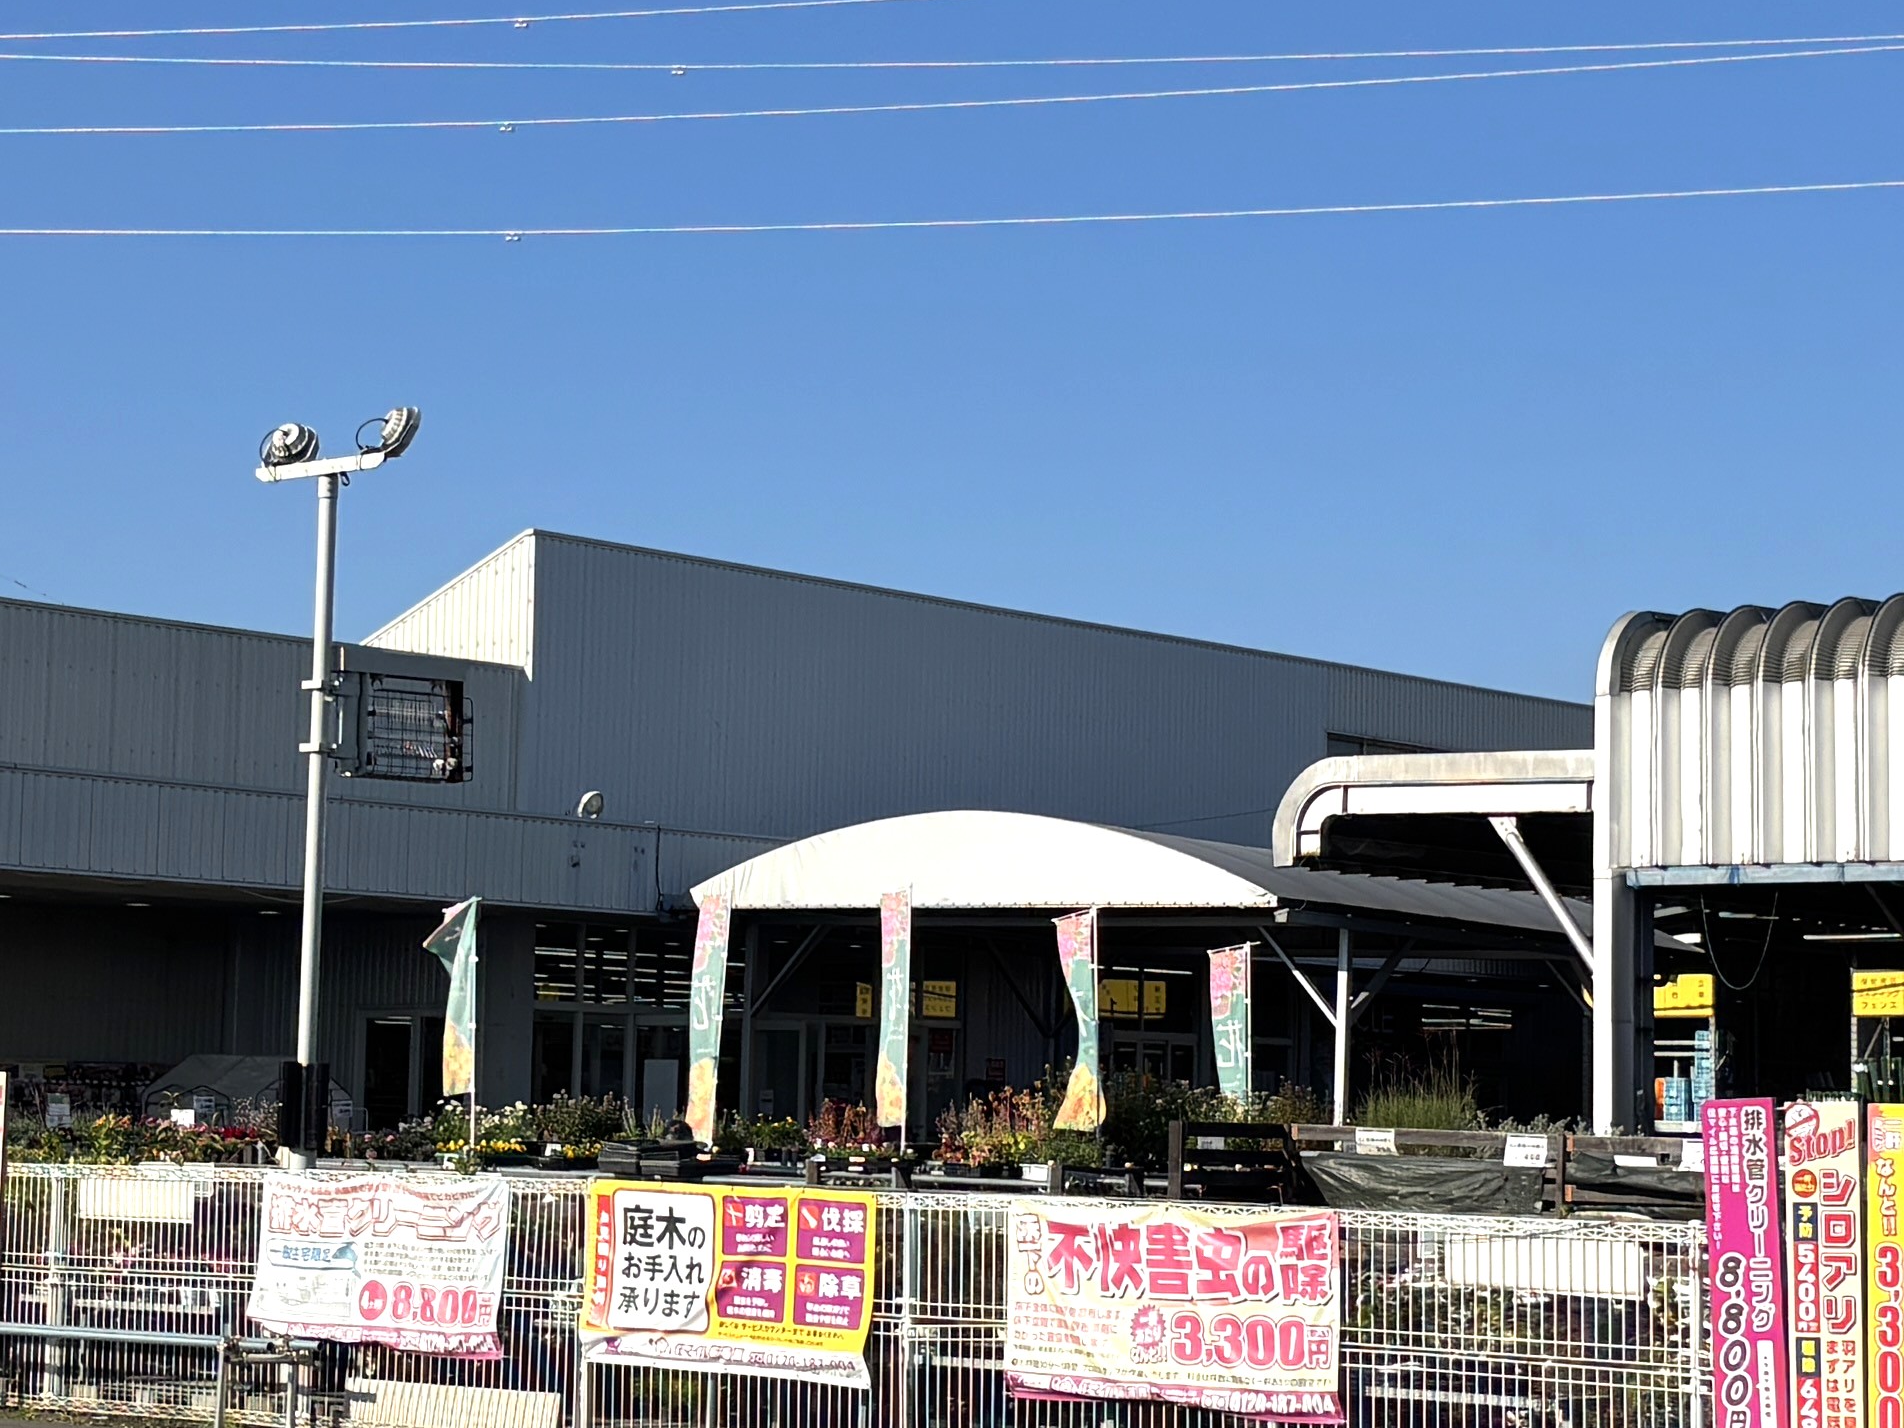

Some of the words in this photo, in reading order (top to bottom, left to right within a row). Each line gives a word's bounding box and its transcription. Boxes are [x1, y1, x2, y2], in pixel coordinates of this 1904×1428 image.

[1788, 1118, 1856, 1166] Stop!
[622, 1204, 706, 1250] 庭木の
[1741, 1105, 1775, 1334] 排水管クリーニング
[621, 1251, 705, 1285] お手入れ
[1818, 1168, 1858, 1335] シロアリ
[740, 1266, 784, 1293] 消毒
[818, 1273, 863, 1300] 除草
[617, 1286, 701, 1319] 承ります
